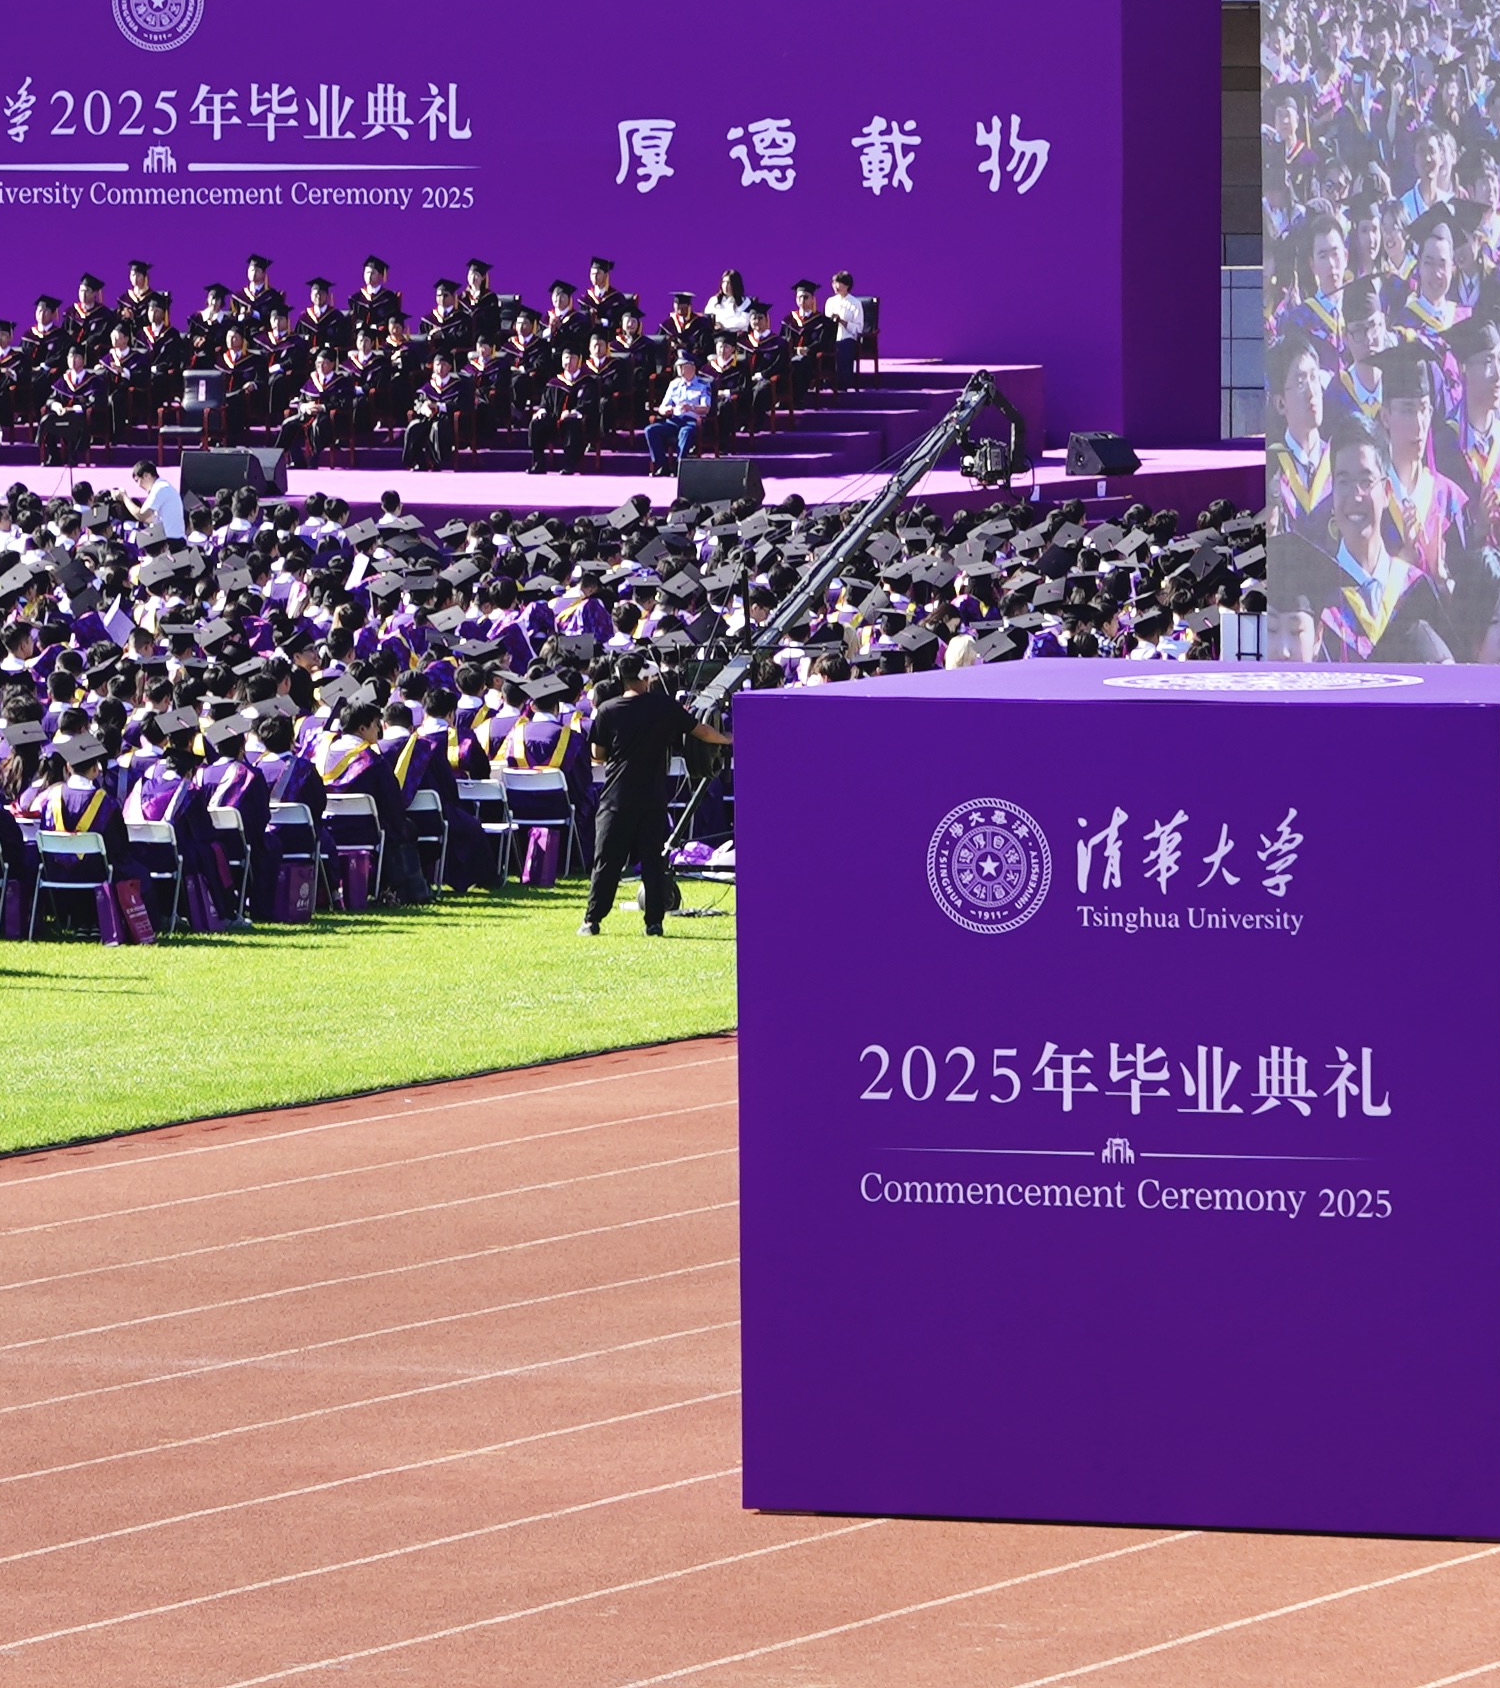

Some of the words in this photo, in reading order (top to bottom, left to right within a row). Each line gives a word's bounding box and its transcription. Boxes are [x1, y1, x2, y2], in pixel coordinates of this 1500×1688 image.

[90, 182, 283, 205] Commencement
[290, 182, 413, 211] Ceremony
[421, 186, 474, 209] 2025
[938, 847, 964, 910] TSINGHUA
[1014, 849, 1041, 910] UNIVERSITY
[1076, 905, 1180, 934] Tsinghua
[1187, 907, 1304, 936] University
[859, 1041, 1392, 1119] 2025年毕业典礼
[860, 1172, 1126, 1209] Commencement
[1137, 1178, 1307, 1219] Ceremony
[1318, 1188, 1392, 1219] 2025
